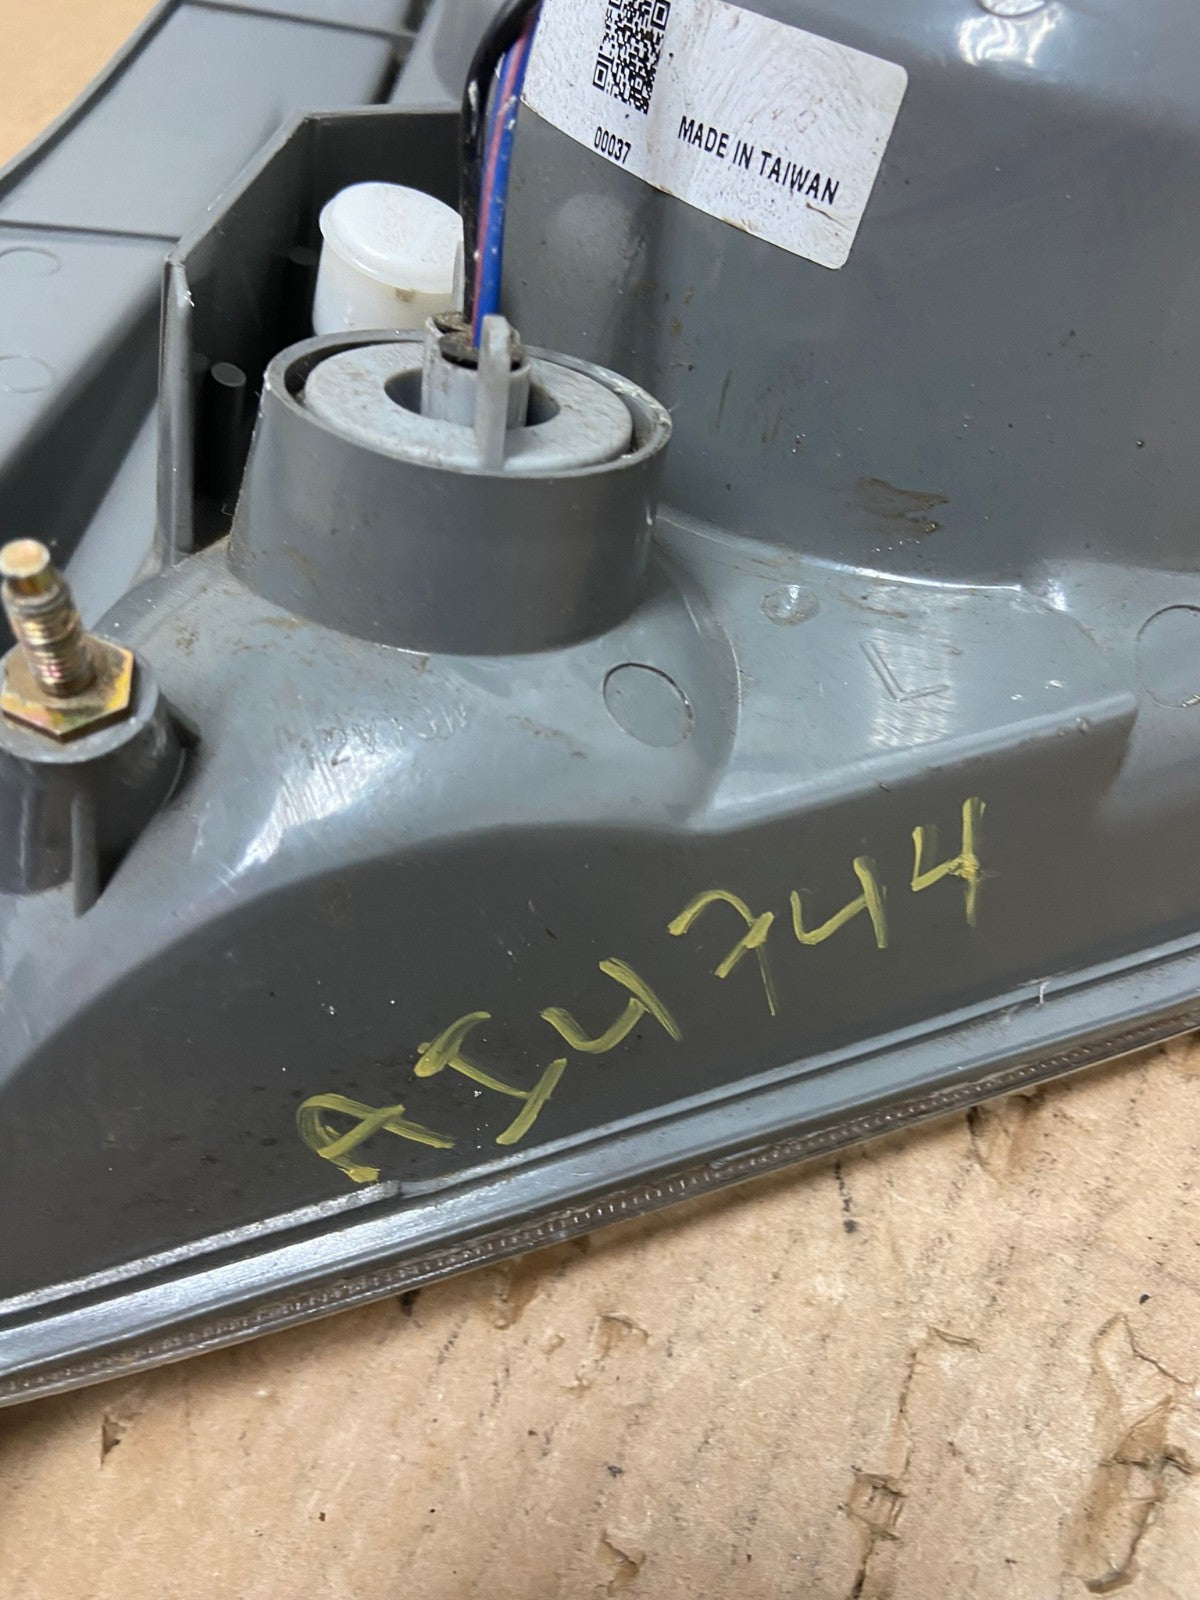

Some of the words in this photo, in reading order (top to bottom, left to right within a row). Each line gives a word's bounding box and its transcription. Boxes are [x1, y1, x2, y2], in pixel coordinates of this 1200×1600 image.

[594, 126, 631, 164] 00037
[678, 115, 728, 159] MADE
[734, 140, 754, 170] IN
[759, 150, 840, 205] TAIWAN
